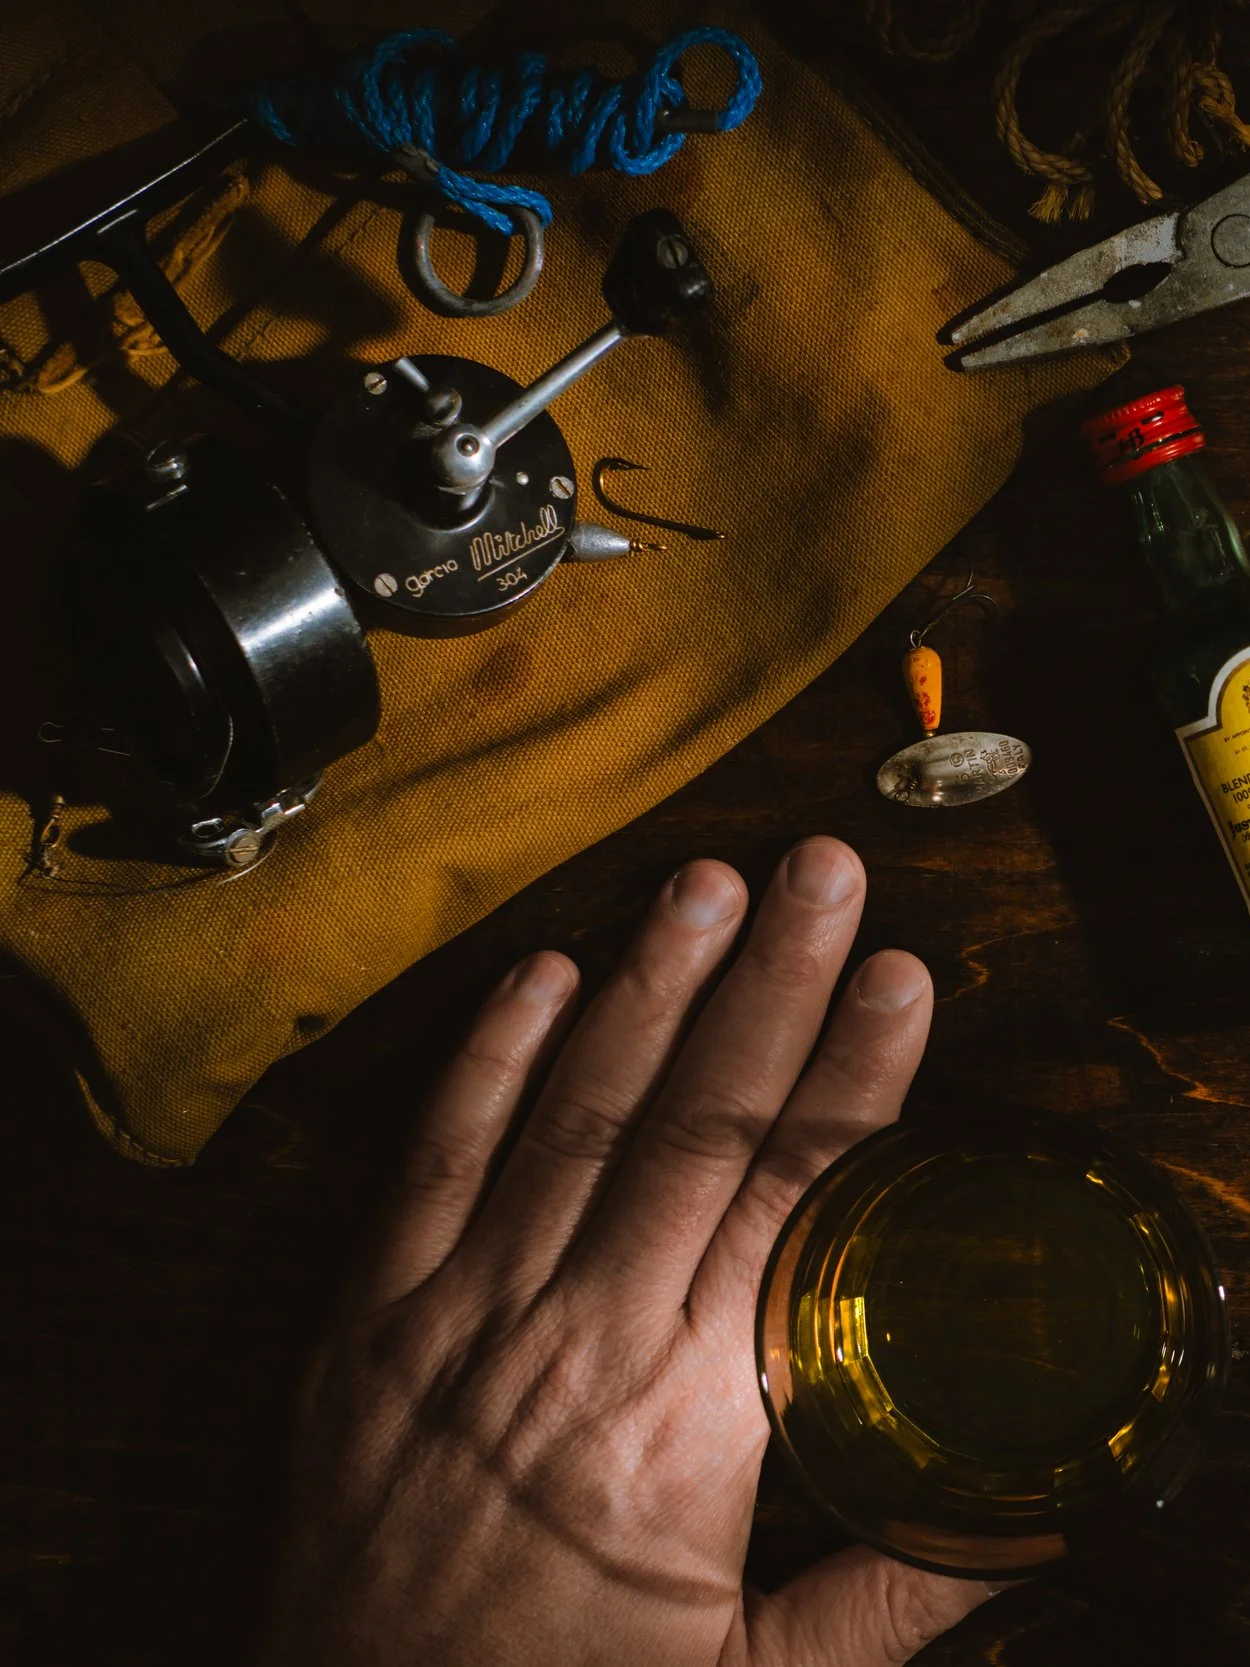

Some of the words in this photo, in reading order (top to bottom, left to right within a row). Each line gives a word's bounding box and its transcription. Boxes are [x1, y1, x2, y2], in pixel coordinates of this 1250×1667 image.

[404, 559, 459, 598] garcia
[469, 504, 565, 572] Mitchell
[496, 566, 528, 592] 304
[965, 748, 985, 791] MARTIN
